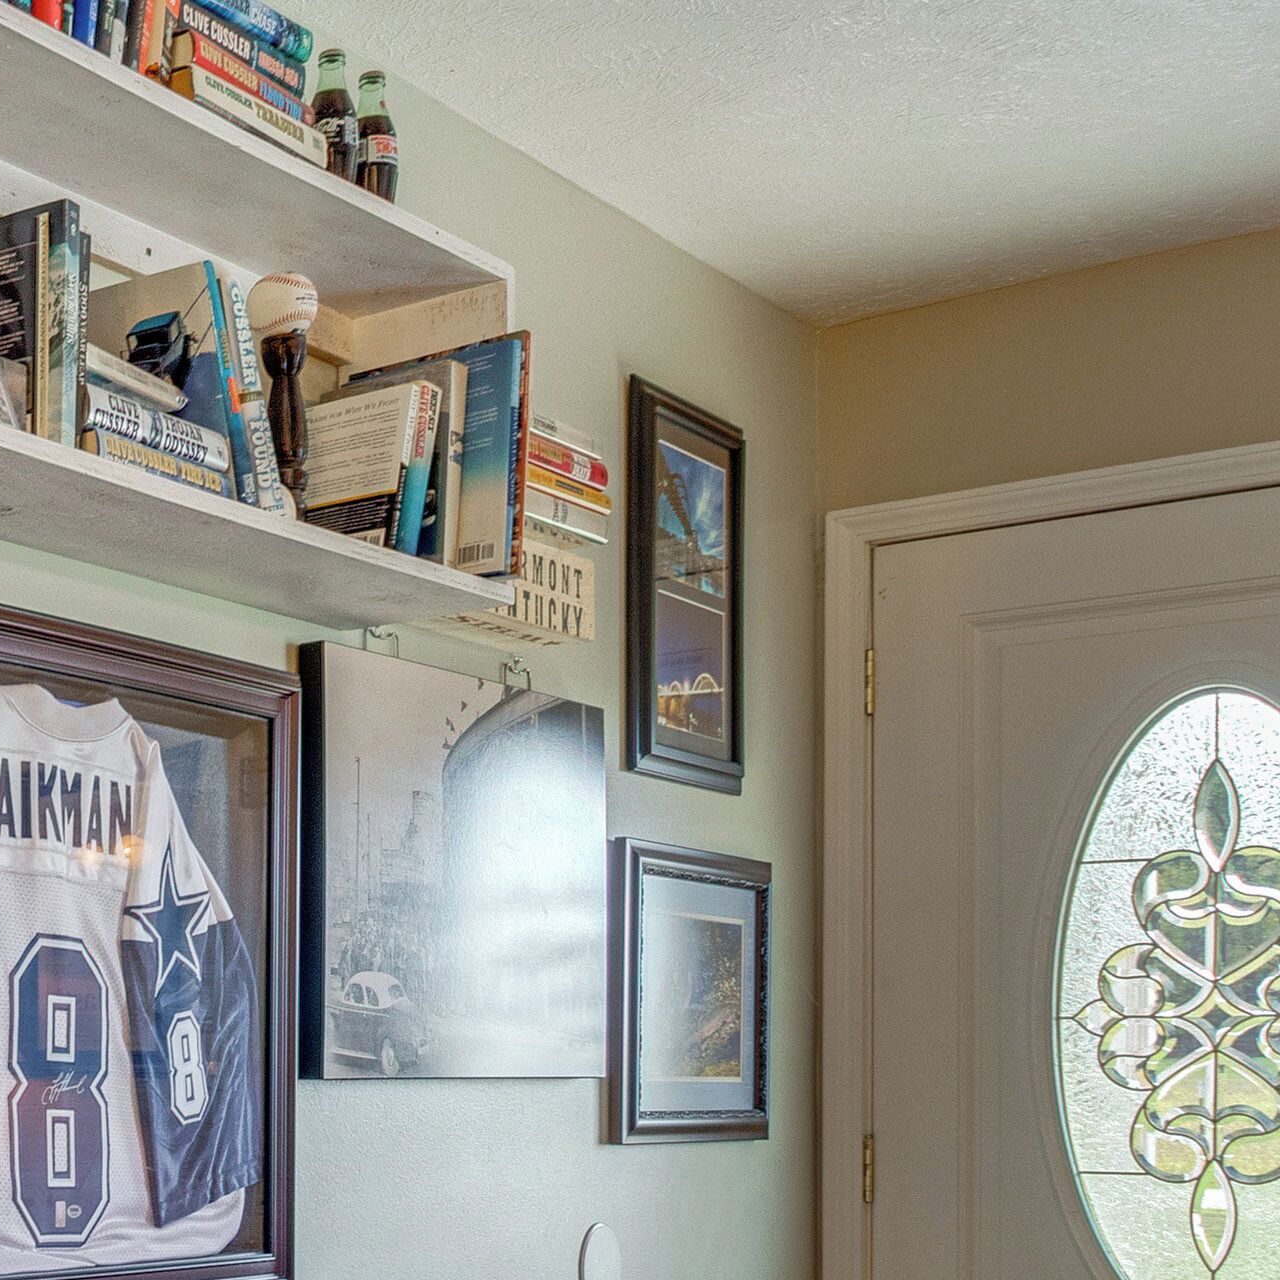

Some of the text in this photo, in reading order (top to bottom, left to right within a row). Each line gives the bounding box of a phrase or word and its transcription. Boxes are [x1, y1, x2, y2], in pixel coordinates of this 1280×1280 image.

[183, 4, 210, 35] CLIVE
[210, 20, 251, 60] CUSSLER
[200, 40, 224, 67] CLIVE
[224, 54, 259, 91] CUSSLER
[259, 80, 285, 111] FLOOD
[254, 101, 305, 144] TREASURE
[79, 283, 89, 319] 5000
[79, 320, 88, 351] YEAR
[231, 286, 257, 386] CUSSLER
[77, 353, 86, 386] LEAP
[94, 408, 140, 441] CUSSLER
[108, 394, 140, 419] CLIVE
[163, 414, 203, 443] TROJAN
[415, 385, 430, 458] CLIVE CUSSLER
[136, 446, 177, 476] CUSSLER
[163, 433, 208, 463] ODYSSEY
[249, 420, 271, 489] FOUND
[520, 548, 584, 600] RMONT
[507, 586, 584, 637] NTUCKY
[9, 932, 109, 1248] 8
[167, 1010, 210, 1126] 8
